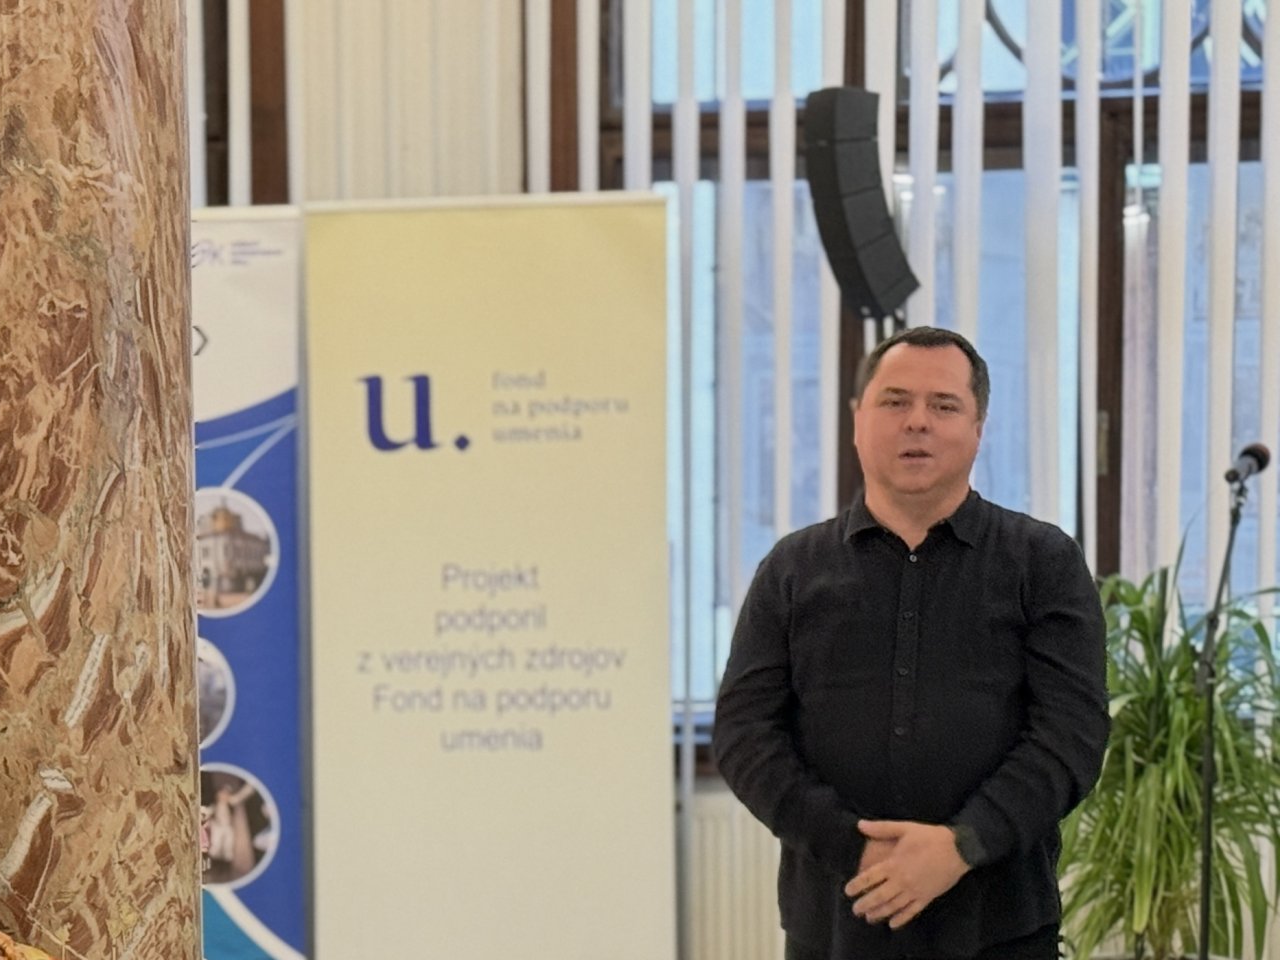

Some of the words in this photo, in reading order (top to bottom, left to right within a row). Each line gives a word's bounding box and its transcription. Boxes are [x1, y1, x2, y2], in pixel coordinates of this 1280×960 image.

[491, 369, 547, 390] fond
[491, 400, 522, 416] na
[527, 396, 630, 420] podporu
[491, 424, 583, 444] umenia
[441, 563, 540, 598] Projekt
[435, 604, 546, 637] podporil
[356, 650, 372, 674] z
[380, 643, 516, 679] verejných
[524, 643, 627, 679] zdrojov
[373, 683, 445, 713] Fond
[451, 689, 488, 713] na
[496, 683, 612, 717] podporu
[439, 727, 544, 753] umenia
